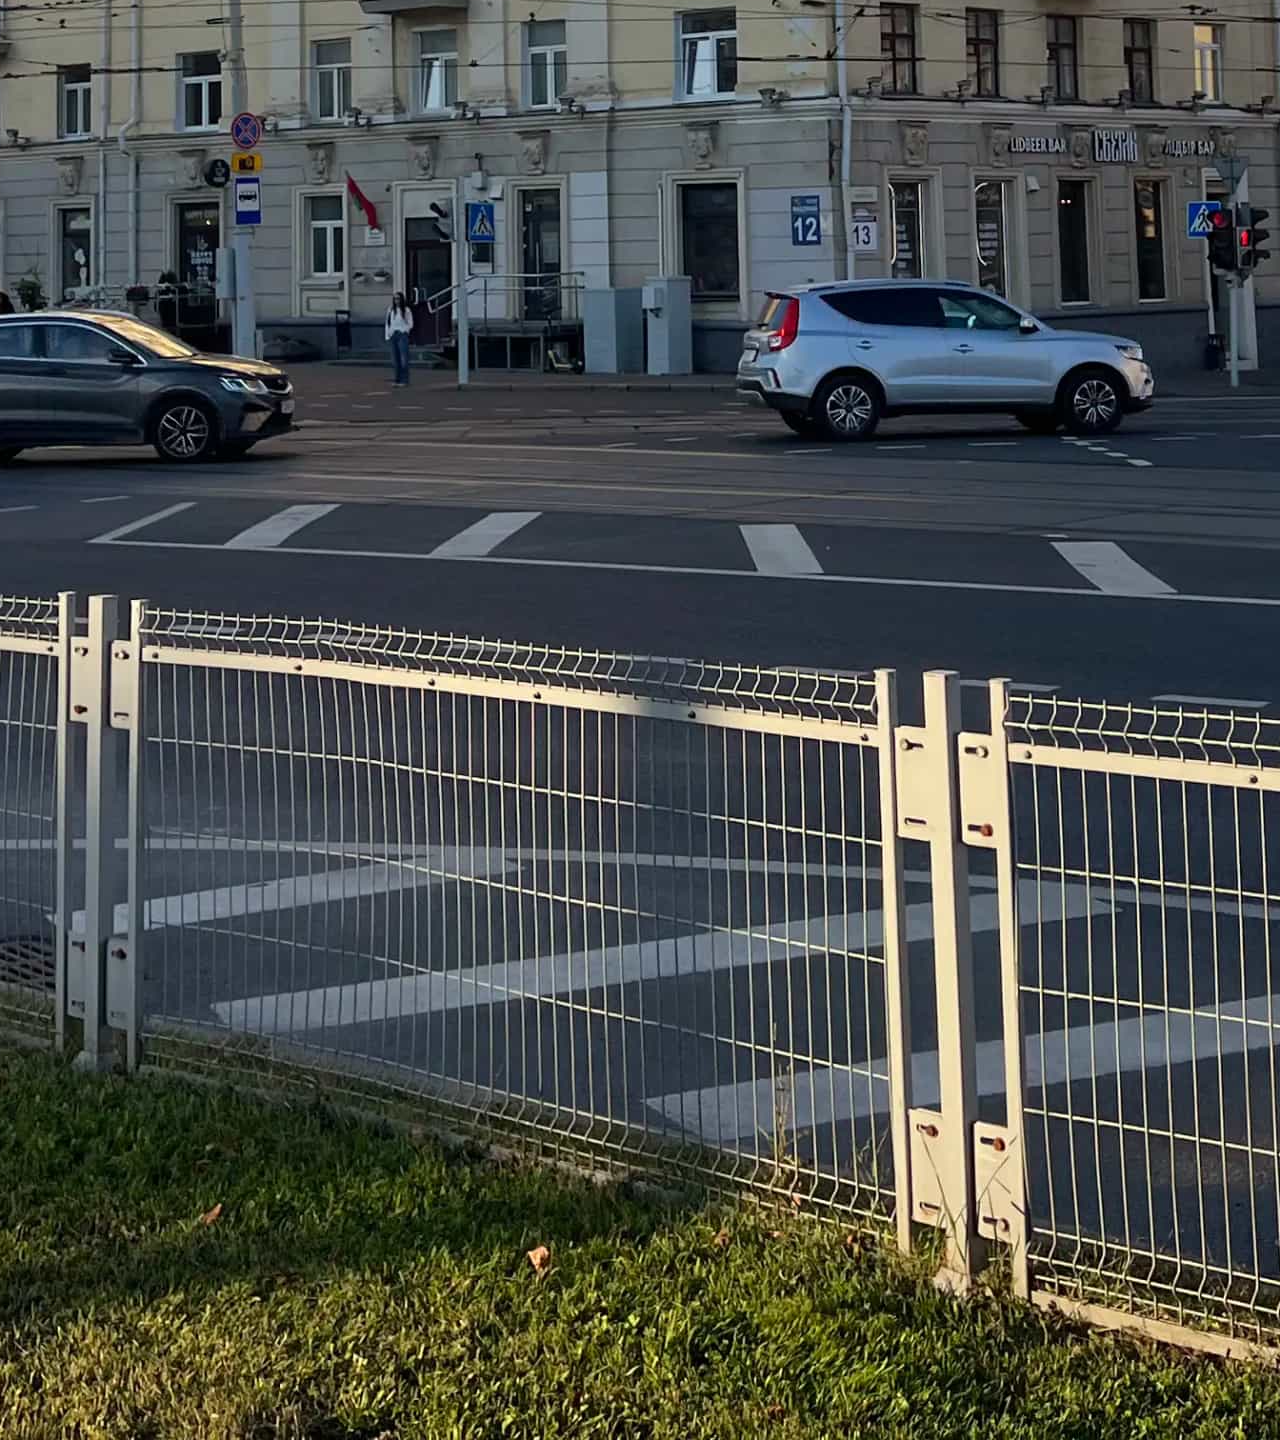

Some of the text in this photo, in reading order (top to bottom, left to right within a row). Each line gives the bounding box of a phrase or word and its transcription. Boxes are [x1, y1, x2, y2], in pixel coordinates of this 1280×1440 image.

[1011, 136, 1067, 153] LIDBEER BAR
[1198, 140, 1215, 155] БАР
[794, 217, 818, 241] 12
[853, 225, 871, 245] 13
